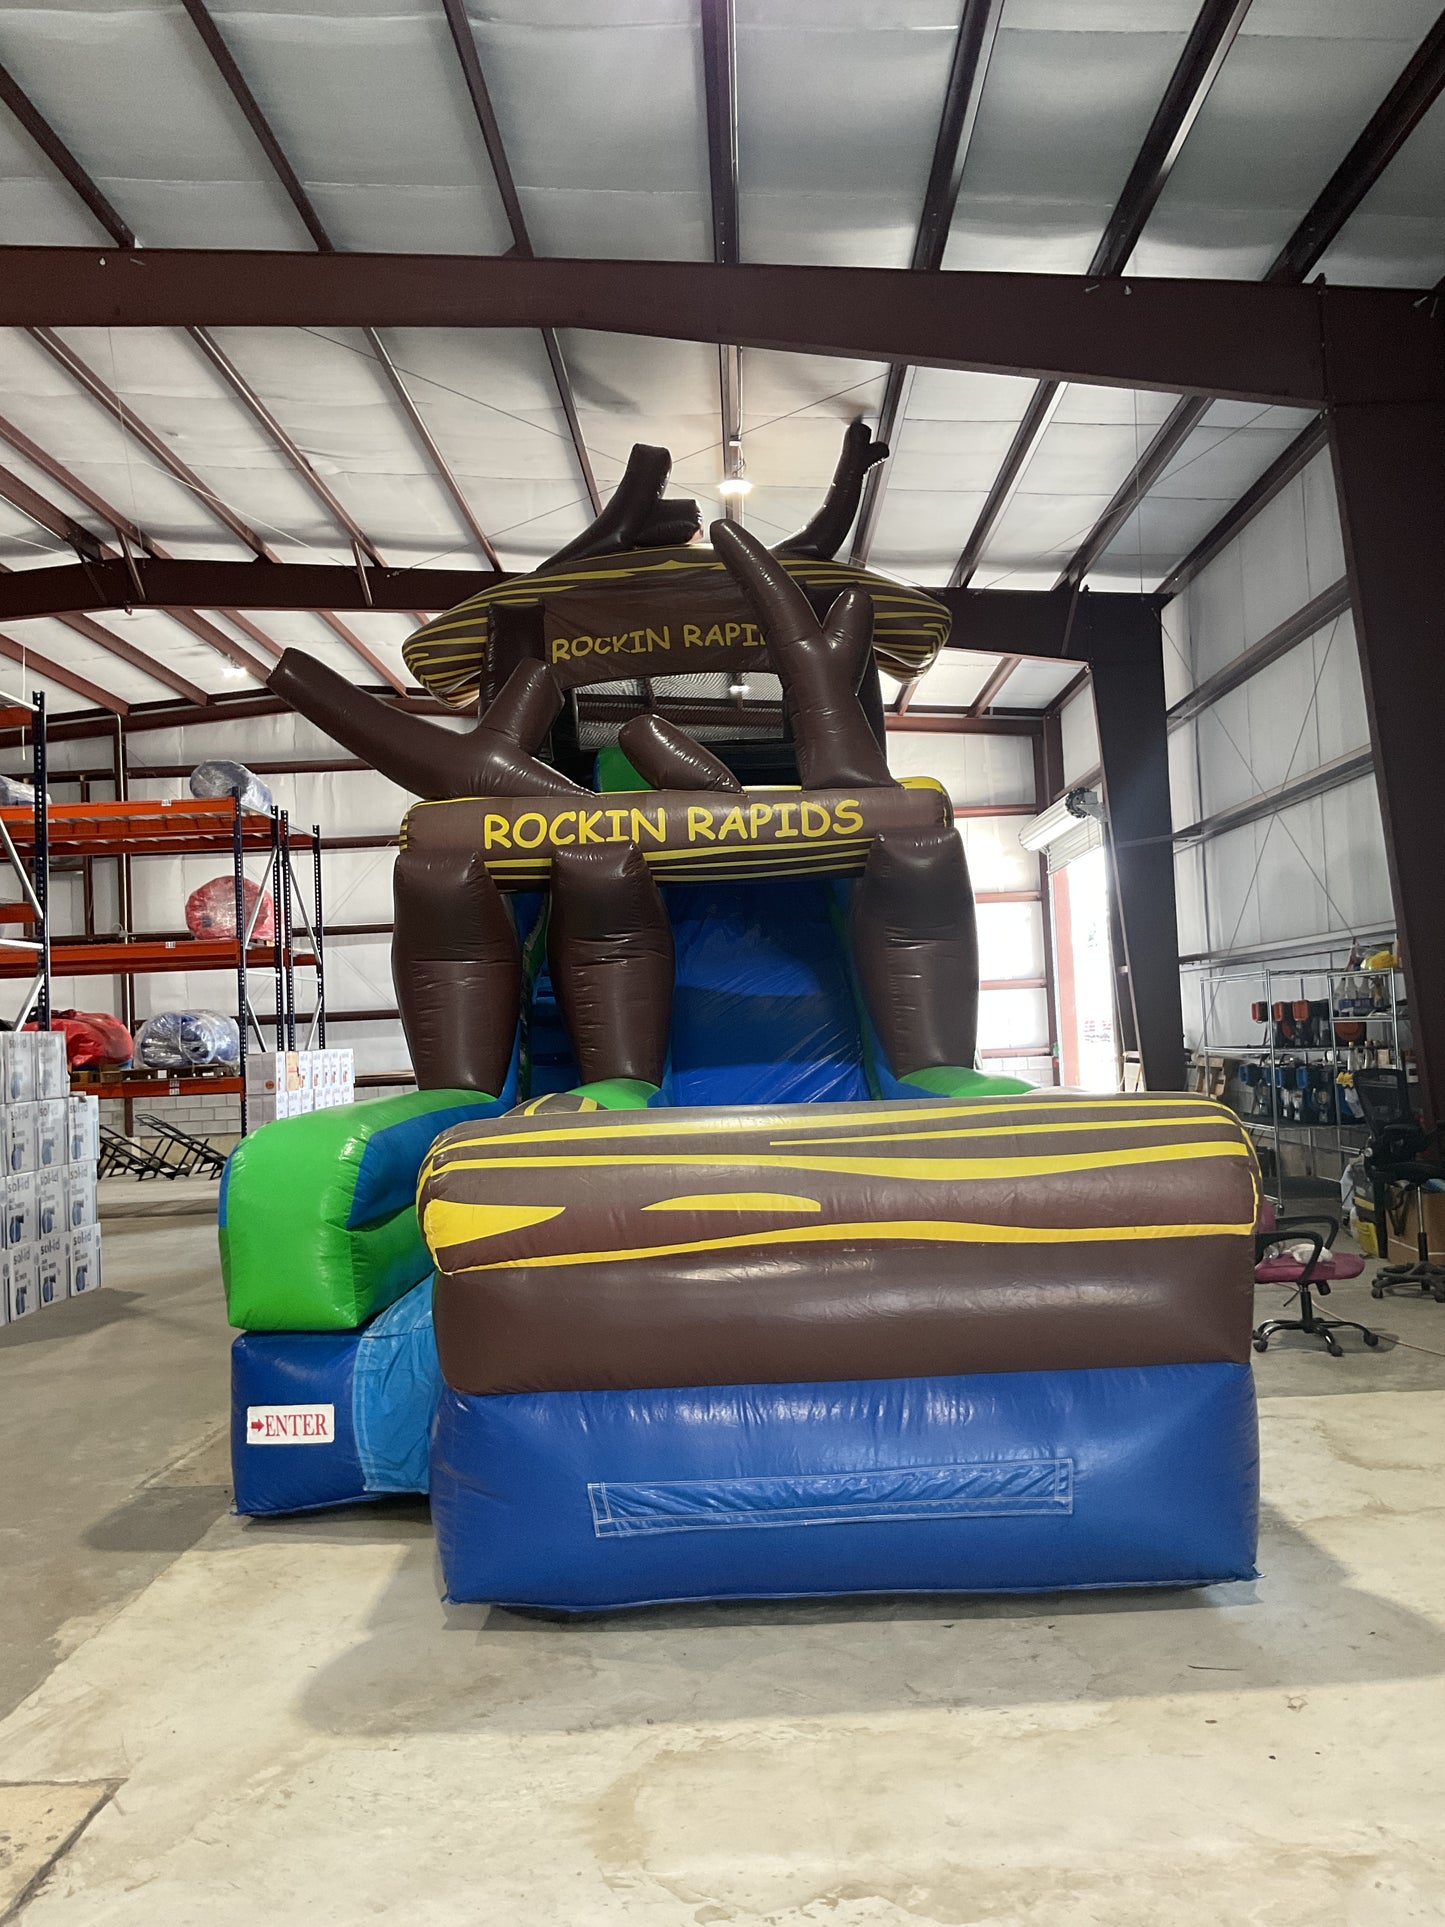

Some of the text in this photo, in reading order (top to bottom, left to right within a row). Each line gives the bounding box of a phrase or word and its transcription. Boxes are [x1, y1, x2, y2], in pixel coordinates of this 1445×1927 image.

[552, 622, 767, 664] ROCKIN RAPI
[484, 799, 864, 849] ROCKIN RAPIDS
[265, 1413, 328, 1437] ENTER
